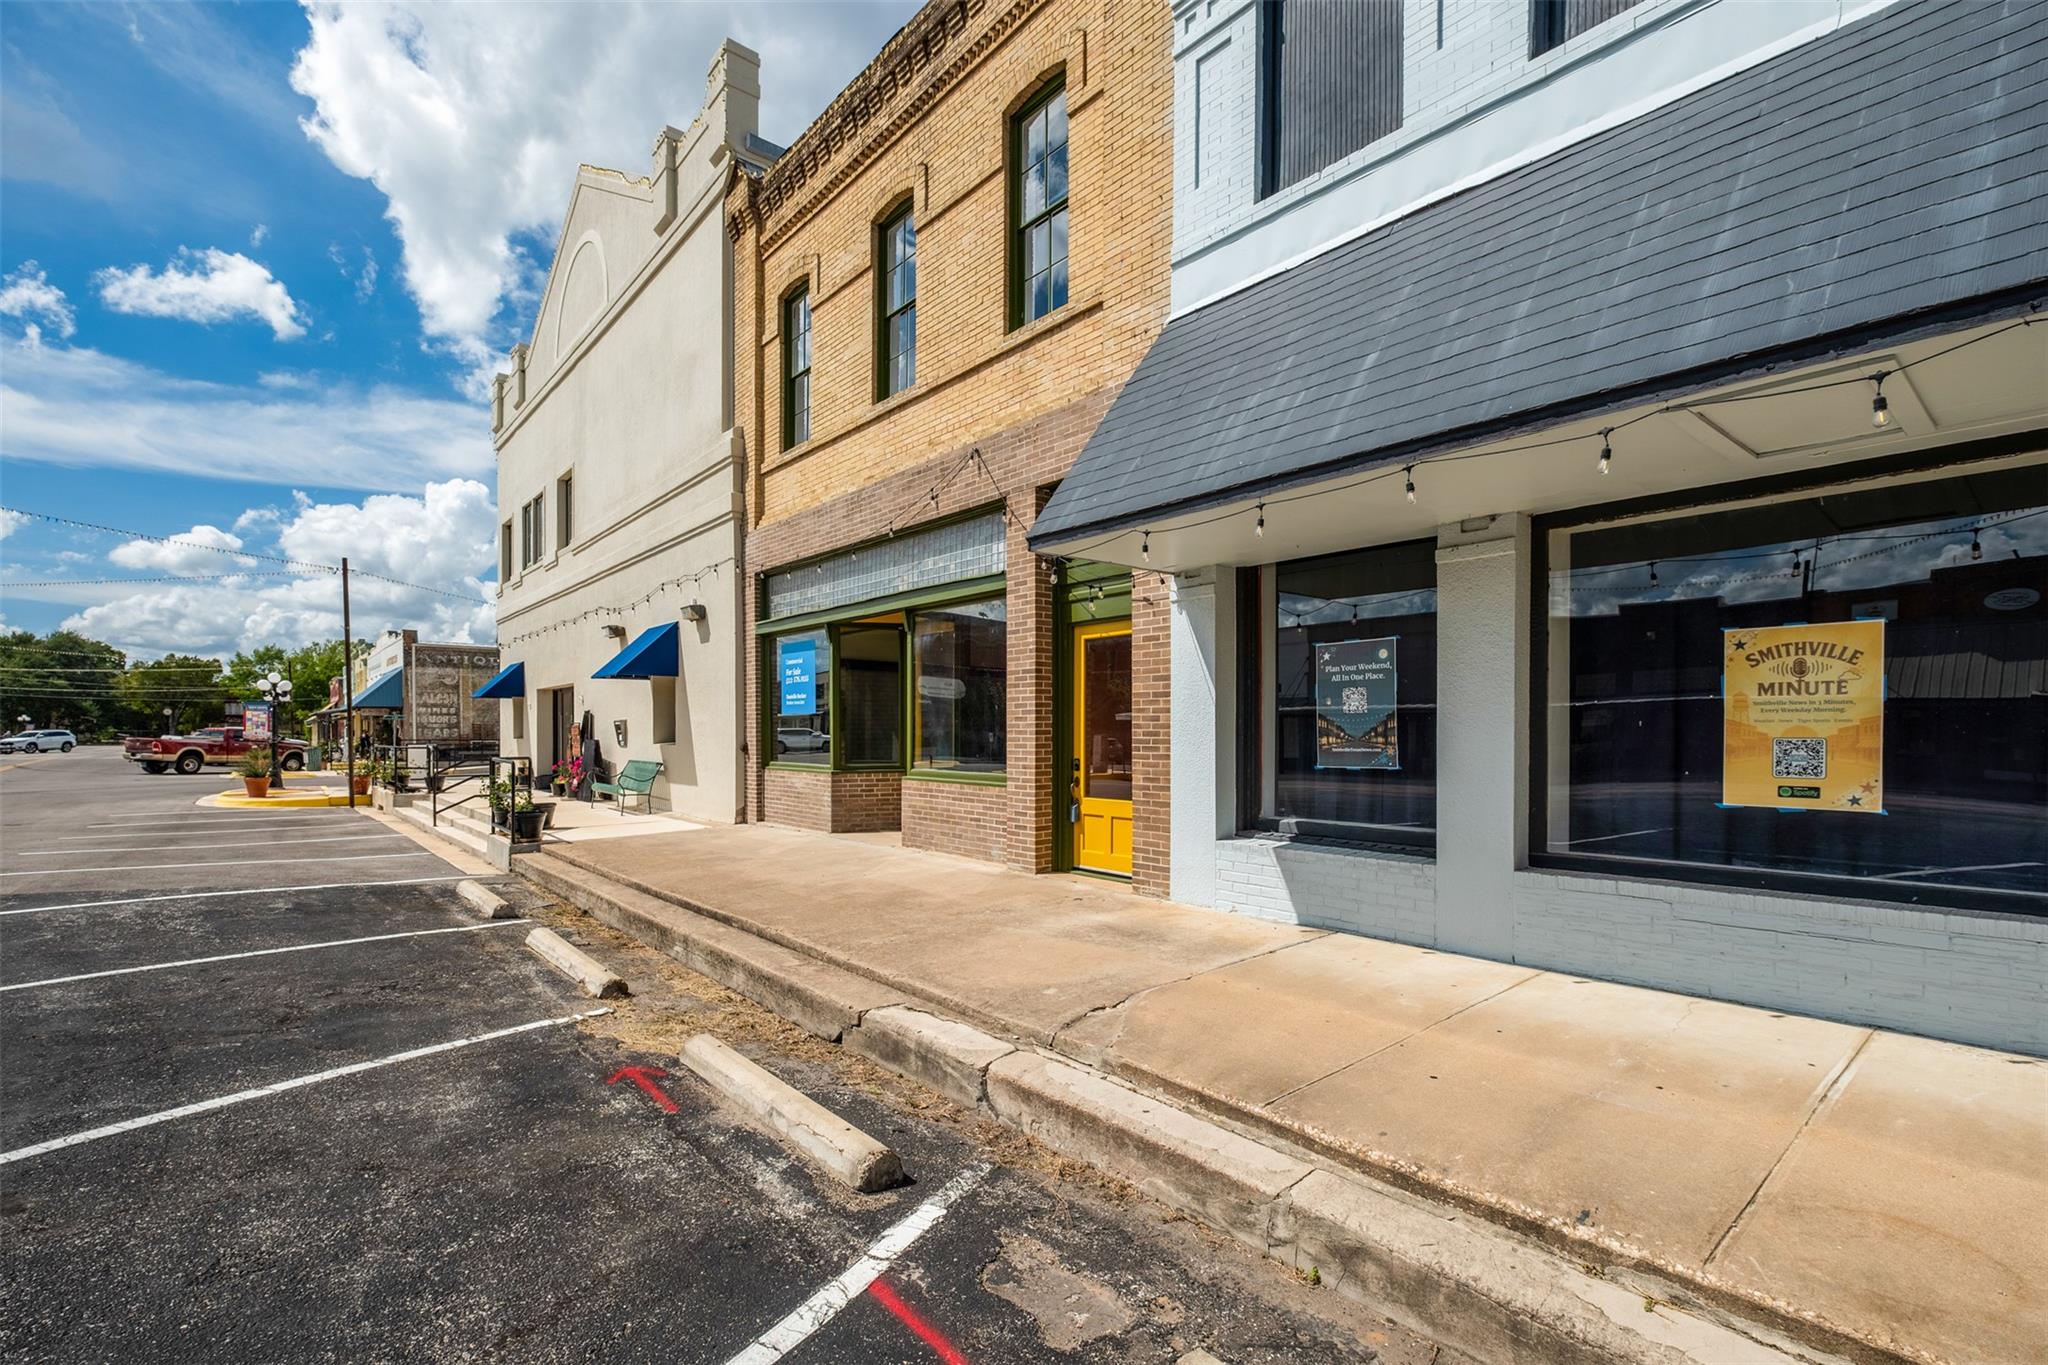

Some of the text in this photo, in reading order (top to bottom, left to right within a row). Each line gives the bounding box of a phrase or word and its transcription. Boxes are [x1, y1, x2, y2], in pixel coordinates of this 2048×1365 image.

[1744, 641, 1865, 668] SMITHVILLE
[793, 667, 801, 675] Sale
[1325, 661, 1393, 673] Plan Your Weekend,
[1331, 674, 1341, 682] All
[1350, 673, 1365, 681] One
[1365, 672, 1386, 680] Place.
[1757, 680, 1849, 697] MINUTE
[1792, 789, 1819, 797] Spotify
